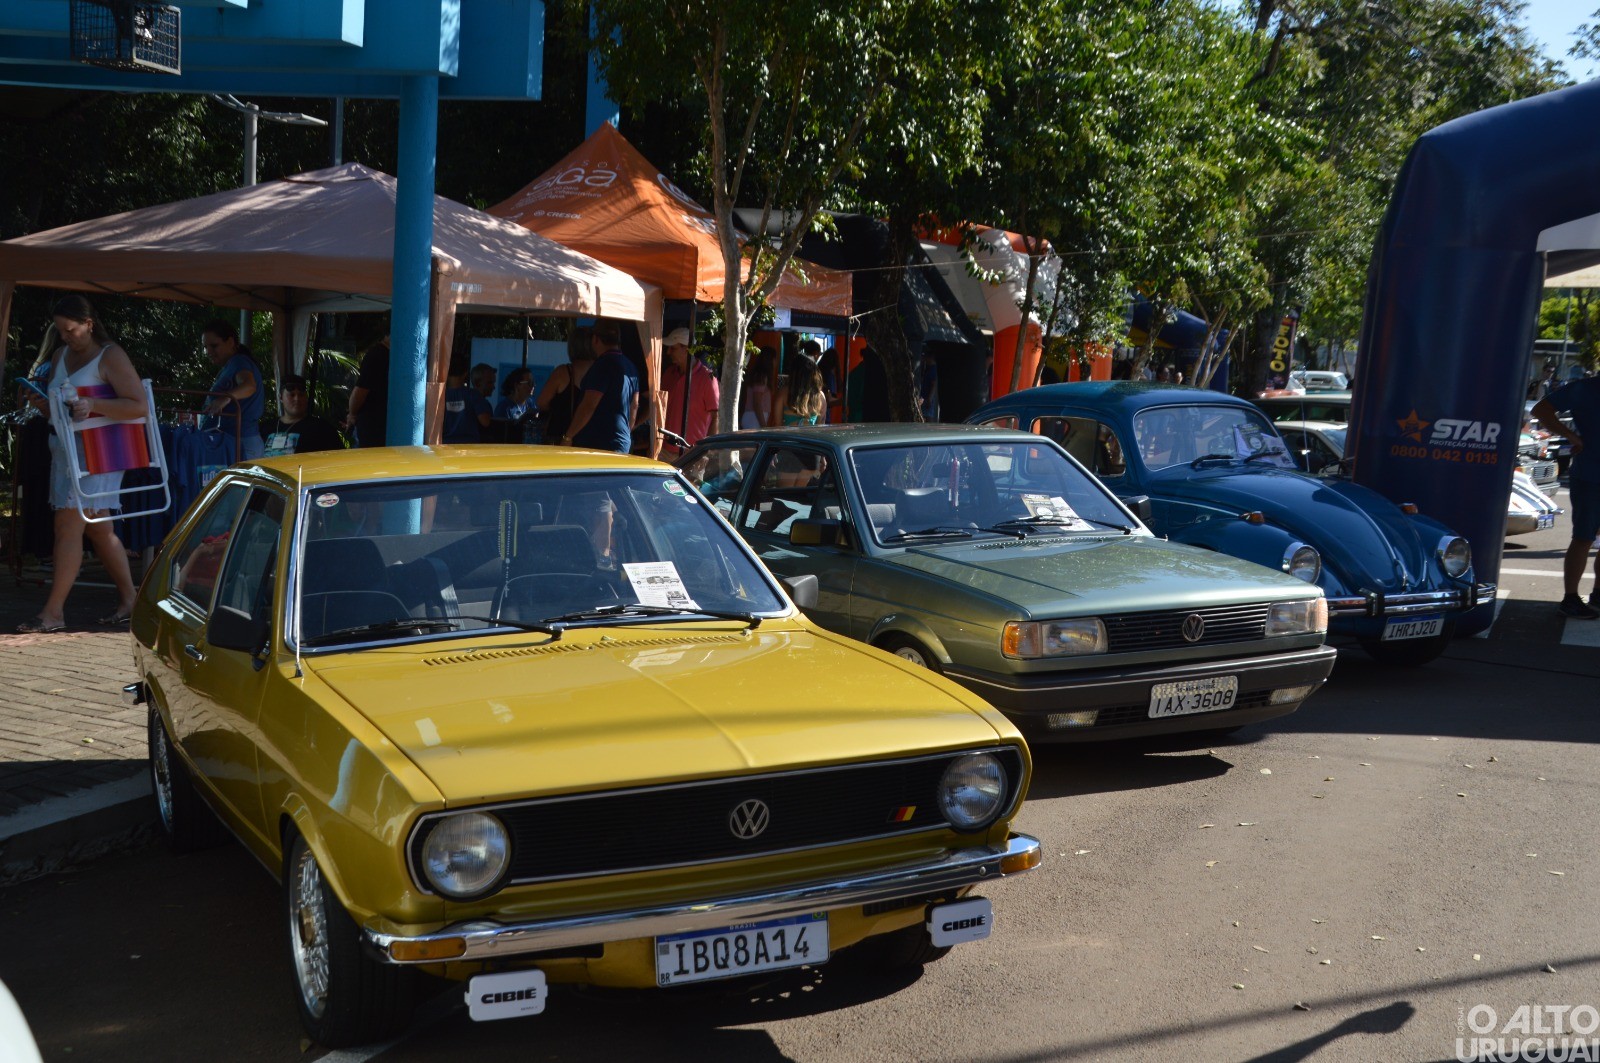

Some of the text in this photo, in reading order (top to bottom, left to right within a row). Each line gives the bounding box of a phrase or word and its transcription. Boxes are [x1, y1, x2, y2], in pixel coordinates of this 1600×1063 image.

[546, 211, 582, 220] CRESOL
[1270, 325, 1290, 372] FOTO
[1431, 418, 1501, 443] STAR
[1429, 439, 1497, 450] PROTEÇÃO VEICULAR
[1391, 445, 1498, 464] 0800 042 0135
[1388, 620, 1437, 638] IHR1J20
[673, 926, 810, 976] IBQ8A14
[660, 972, 671, 984] BR
